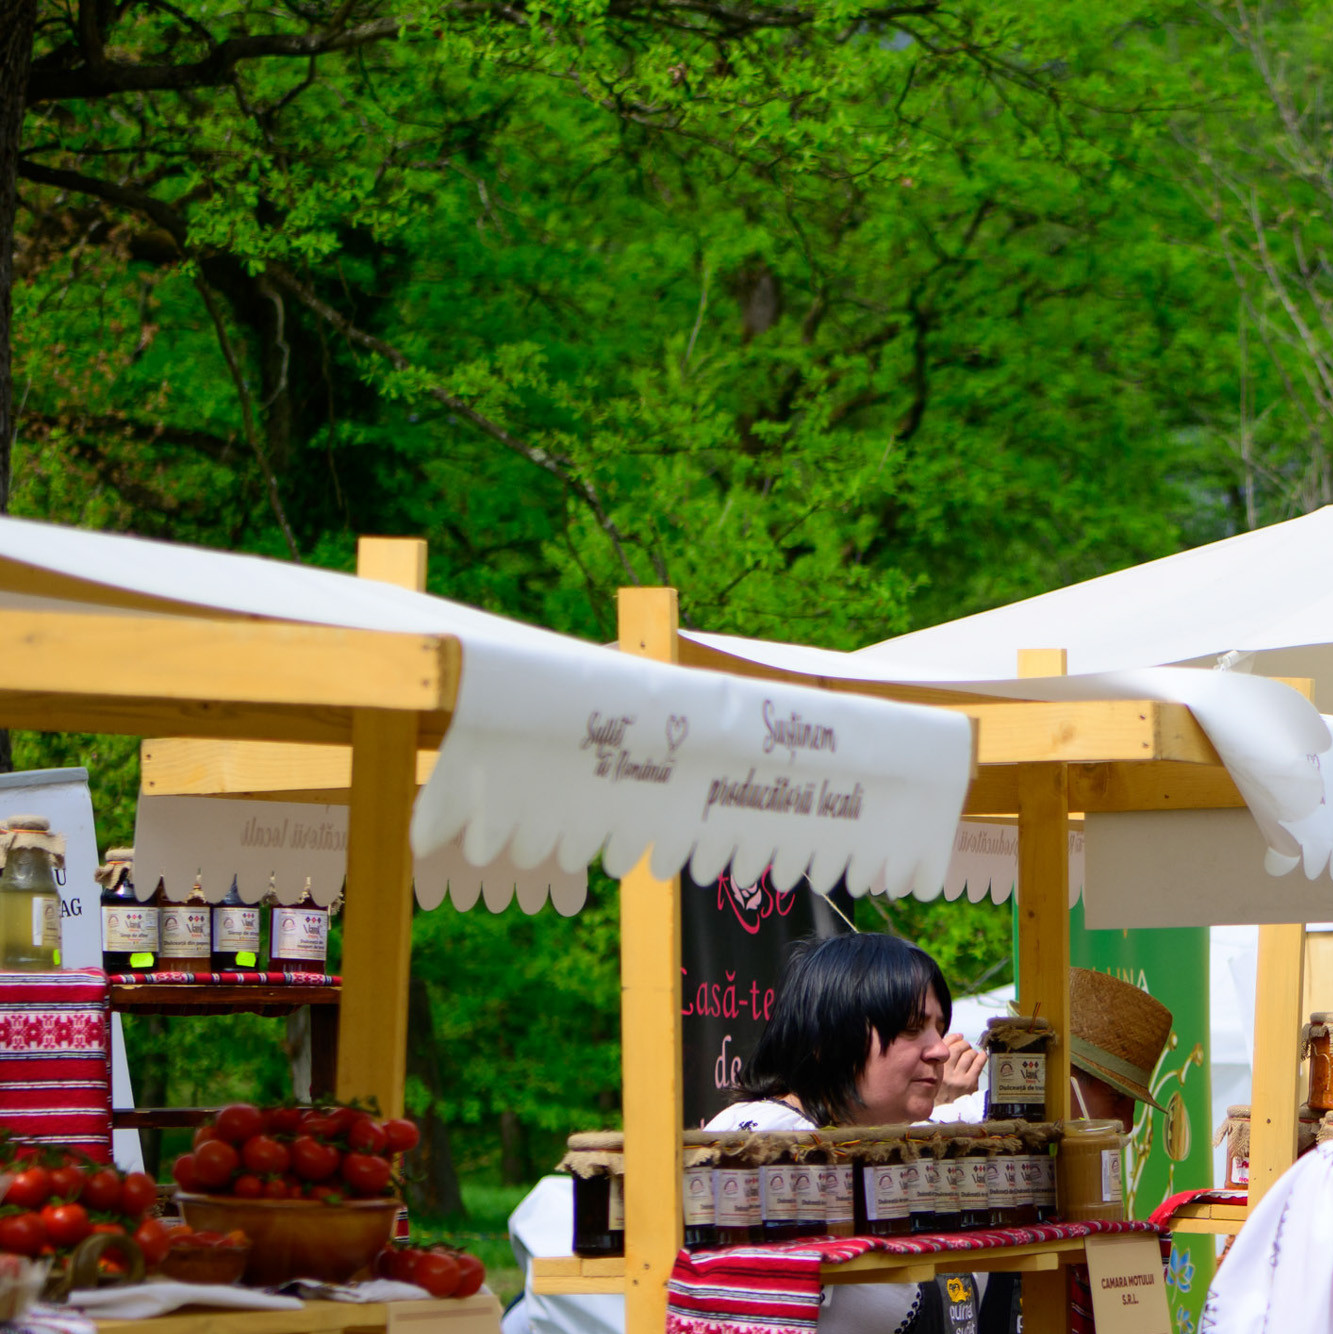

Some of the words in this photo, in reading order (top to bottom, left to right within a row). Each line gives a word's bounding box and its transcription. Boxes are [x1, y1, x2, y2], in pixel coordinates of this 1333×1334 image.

[715, 1034, 742, 1089] de
[1101, 1276, 1127, 1289] CAMARA
[1128, 1274, 1154, 1286] MOTULUI
[1122, 1294, 1139, 1305] S.R.L.
